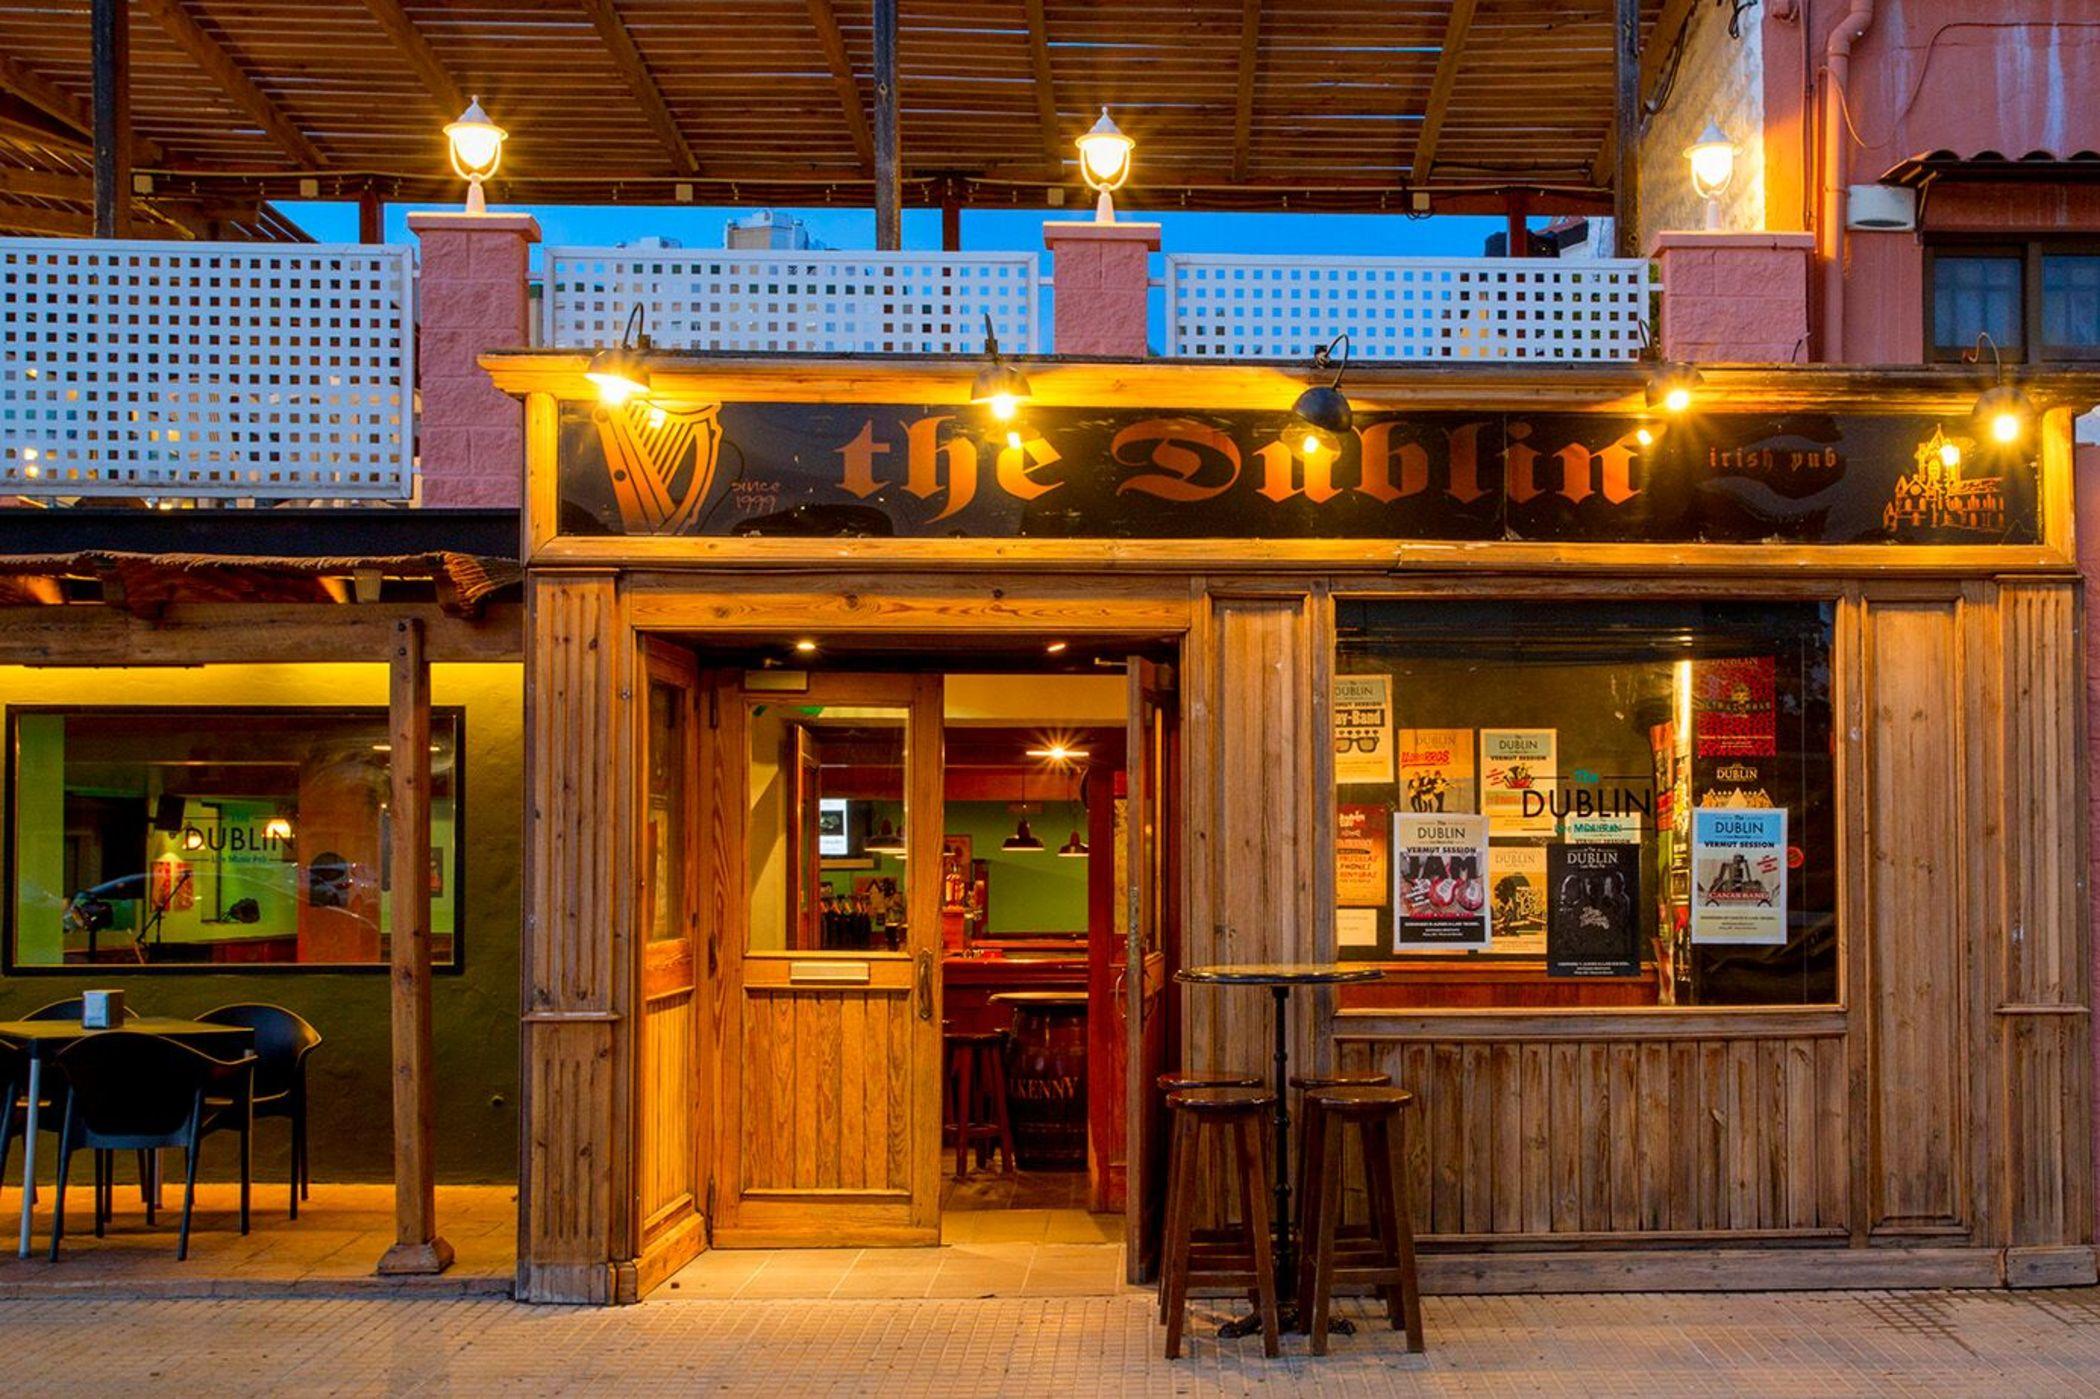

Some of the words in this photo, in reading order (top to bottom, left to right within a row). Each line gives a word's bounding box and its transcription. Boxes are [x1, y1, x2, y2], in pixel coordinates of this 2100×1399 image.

[1709, 446, 1773, 473] irish
[1790, 446, 1838, 472] pub
[834, 415, 1066, 524] the
[1111, 419, 1668, 506] Dublin
[736, 495, 776, 515] 1999
[1336, 710, 1381, 728] ay-Band
[1499, 740, 1538, 750] DUBLIN
[1716, 768, 1758, 779] DUBLIN
[1522, 787, 1652, 819] DUBLIN
[1417, 827, 1466, 839] DUBLIN
[1715, 822, 1764, 833] DUBLIN
[185, 827, 295, 851] DUBLIN
[1566, 852, 1618, 864] DUBLIN
[1408, 856, 1477, 880] JAM
